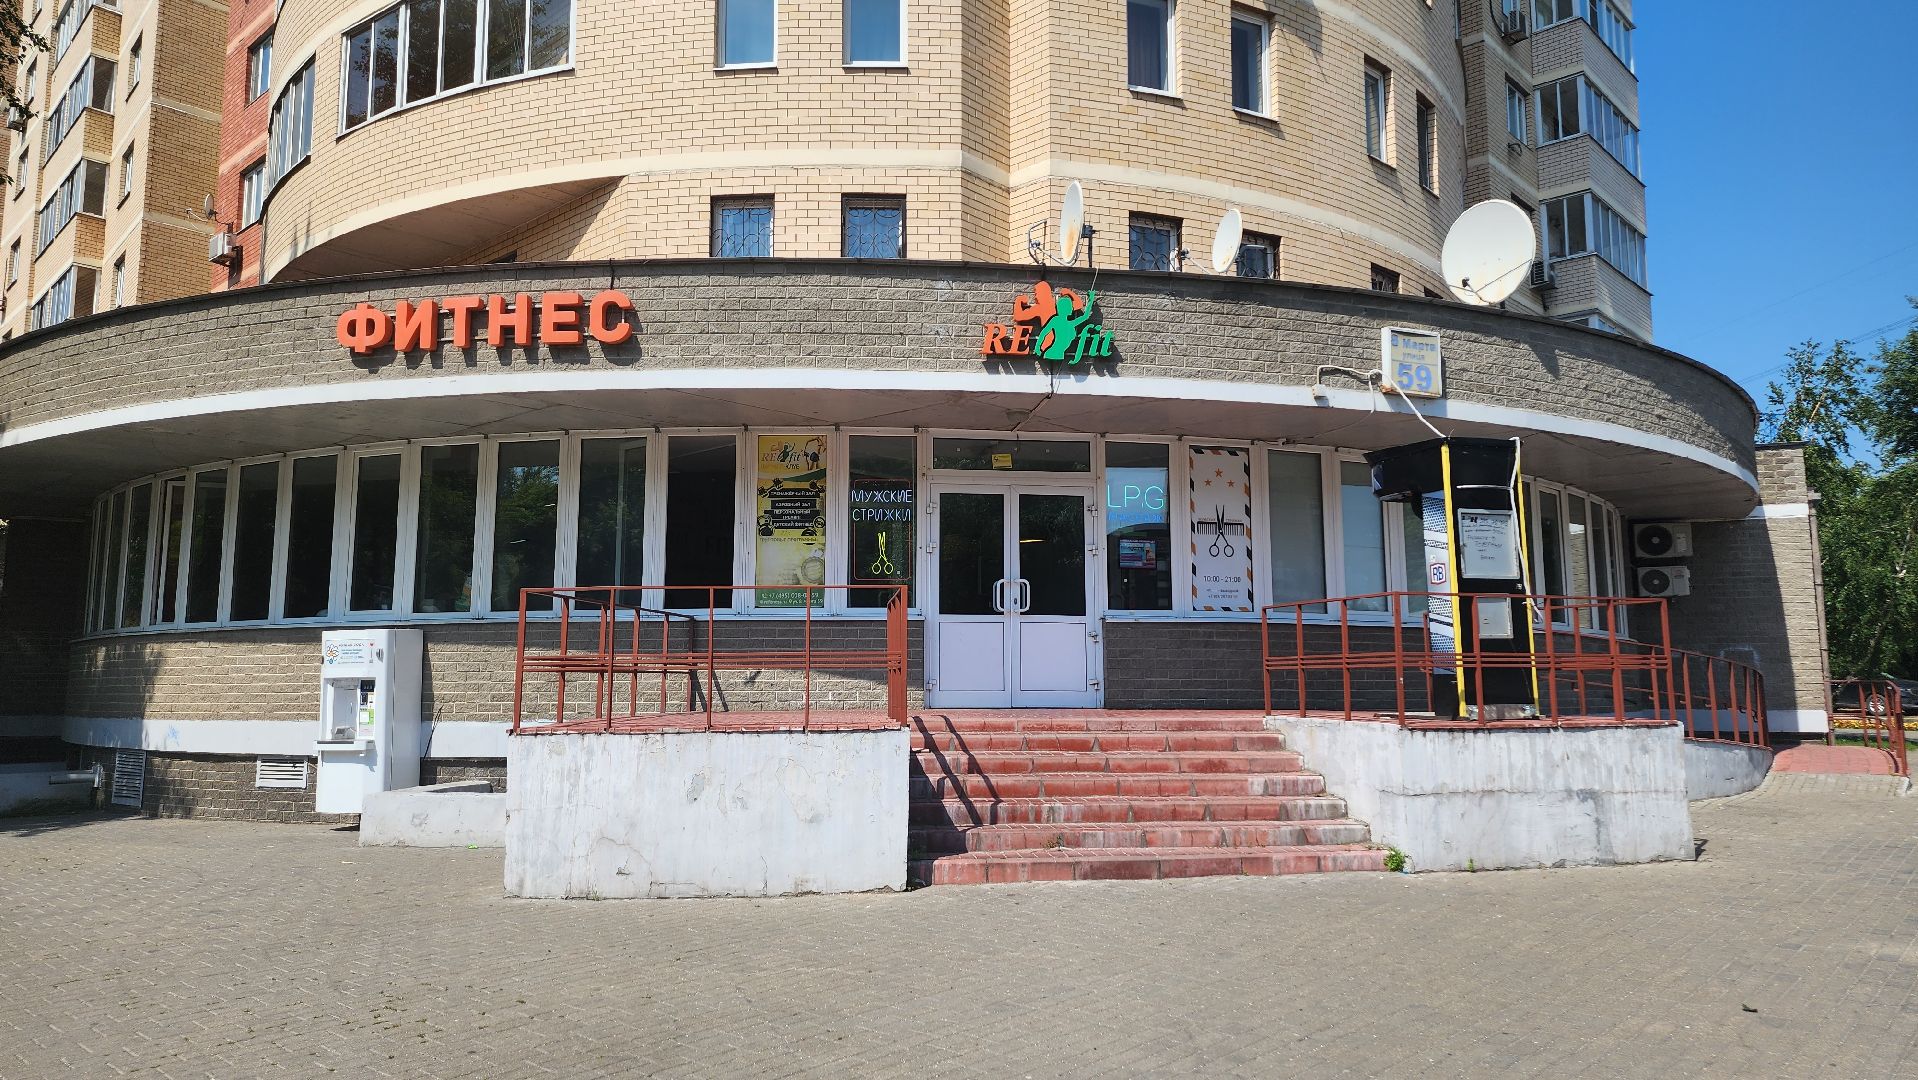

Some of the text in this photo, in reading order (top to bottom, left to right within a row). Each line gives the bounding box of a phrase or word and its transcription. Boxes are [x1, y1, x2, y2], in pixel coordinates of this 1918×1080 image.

[337, 289, 635, 354] ФИТНЕС
[980, 323, 1115, 365] RE fit
[1391, 334, 1437, 351] 8 Марта
[1402, 352, 1425, 360] улица
[1397, 363, 1432, 391] 59
[851, 490, 913, 503] МУЖСКИЕ
[852, 508, 911, 522] СТРИЖКИ
